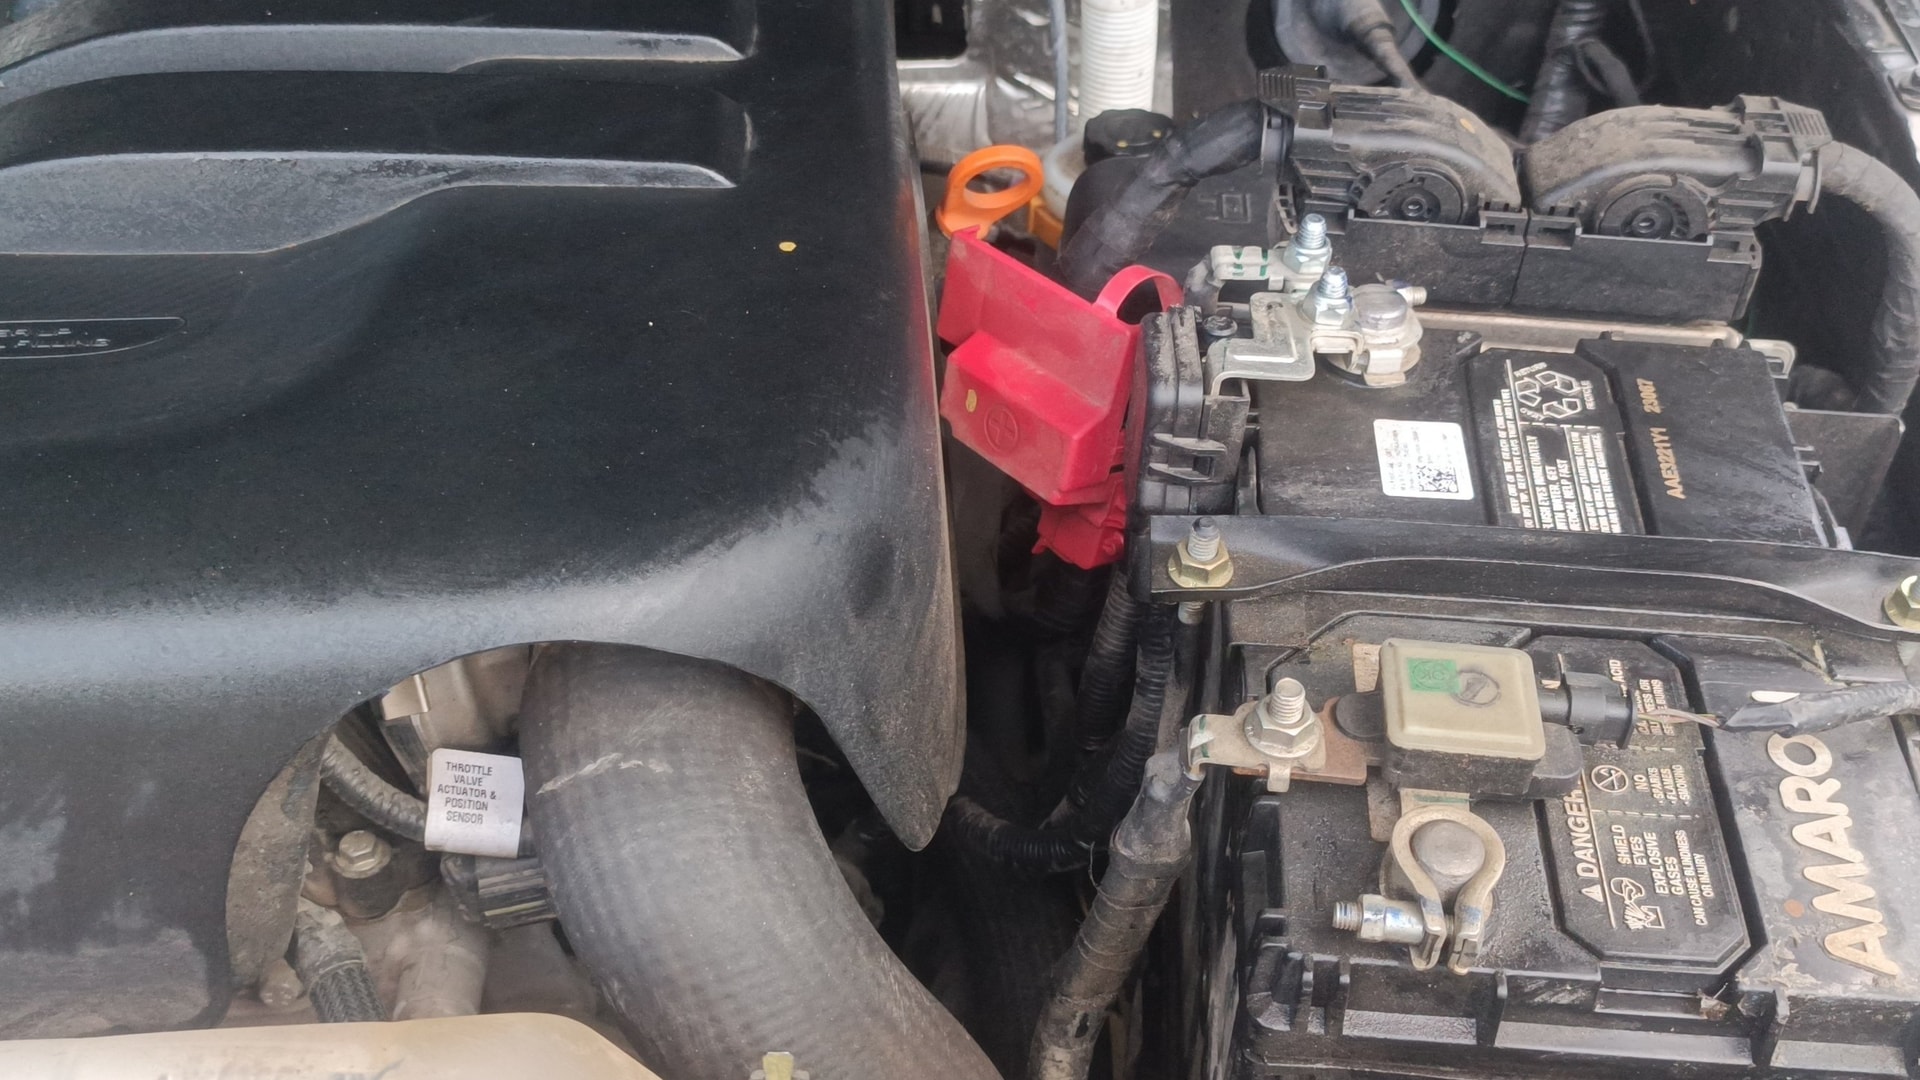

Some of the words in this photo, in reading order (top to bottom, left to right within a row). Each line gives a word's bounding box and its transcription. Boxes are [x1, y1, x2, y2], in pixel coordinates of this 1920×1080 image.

[1545, 466, 1559, 481] GET
[1556, 459, 1571, 478] FAST
[1535, 486, 1550, 506] EYES
[1609, 659, 1626, 682] ACID
[446, 761, 493, 776] THROTTLE
[453, 774, 483, 786] VALVE
[1633, 774, 1649, 792] NO
[437, 784, 487, 798] ACTUATOR
[489, 790, 497, 800] &
[444, 797, 489, 811] POSITION
[446, 810, 484, 824] SENSOR
[1611, 824, 1632, 865] SHIELD
[1629, 835, 1647, 866] EYES
[1675, 830, 1696, 878] BLINDNESS
[1643, 831, 1670, 895] EXPLOSIVE
[1693, 854, 1711, 882] INJURY
[1664, 856, 1685, 895] GASES
[1686, 878, 1702, 906] CAUSE
[1700, 883, 1714, 898] OR
[1694, 907, 1708, 926] CAN
